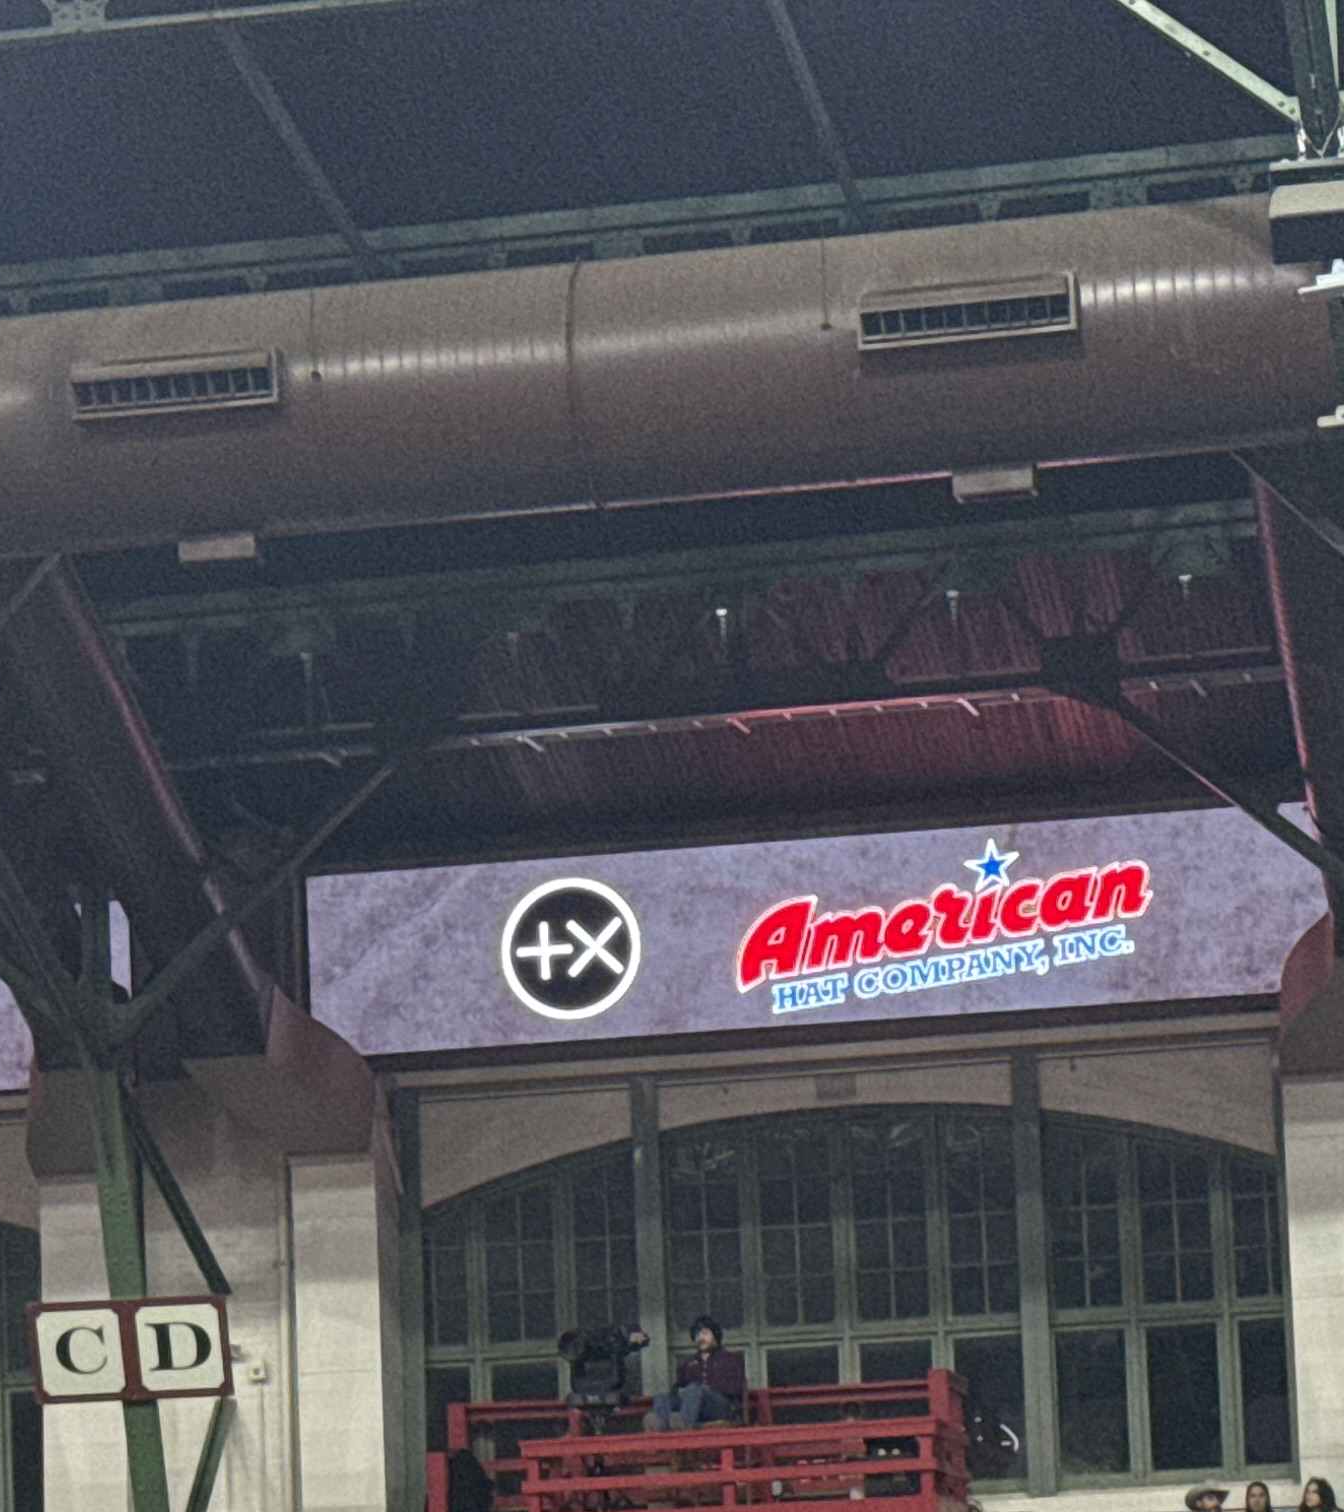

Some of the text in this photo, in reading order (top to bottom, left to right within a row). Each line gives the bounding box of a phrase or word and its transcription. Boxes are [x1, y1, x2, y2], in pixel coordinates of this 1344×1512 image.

[736, 859, 1153, 993] American
[773, 925, 1135, 1014] HAT COMPANY, INC.
[56, 1321, 212, 1374] C D
